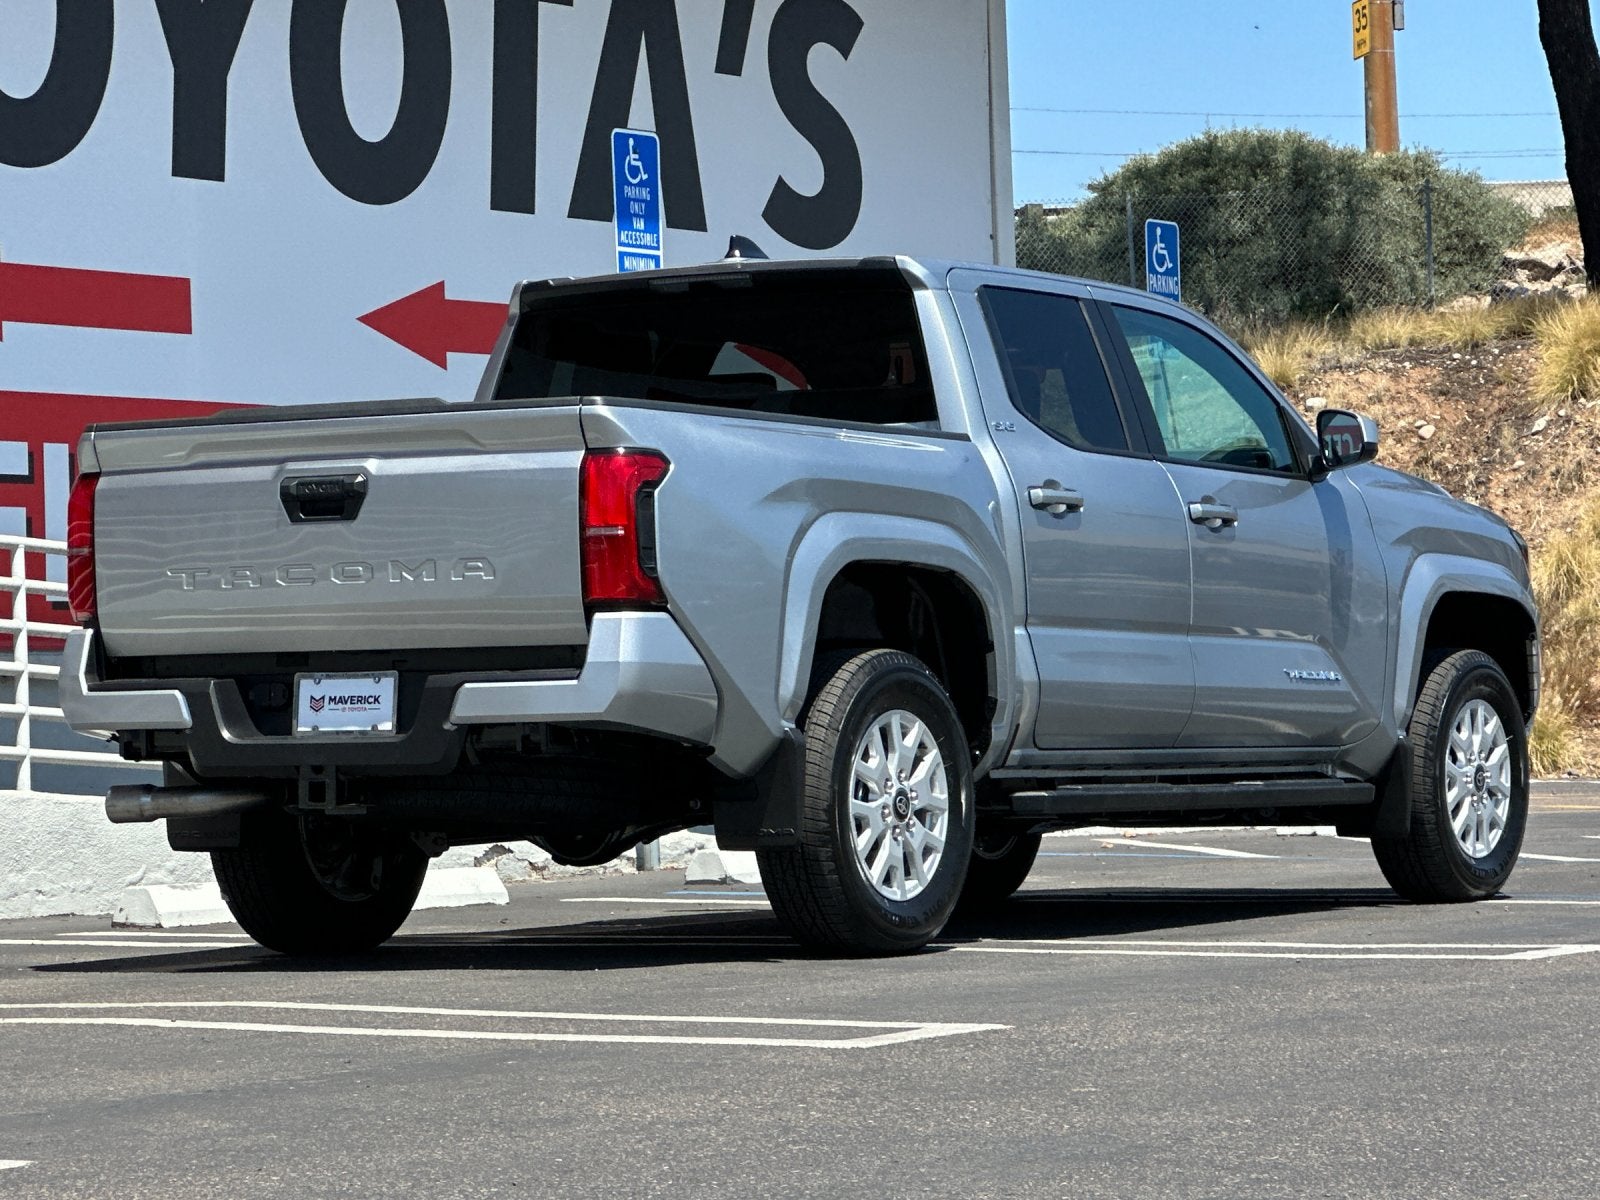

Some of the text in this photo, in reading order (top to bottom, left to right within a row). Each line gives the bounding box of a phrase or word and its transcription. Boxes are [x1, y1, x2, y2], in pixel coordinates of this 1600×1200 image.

[1355, 5, 1368, 33] 35
[624, 185, 651, 201] PARKING
[629, 201, 646, 215] ONLY
[632, 217, 645, 230] VAN
[620, 231, 658, 247] ACCESSIBLE
[623, 255, 656, 271] MINIMUM
[1149, 273, 1179, 295] PARKING
[166, 556, 497, 591] TACOMA
[328, 695, 382, 706] MAVERICK
